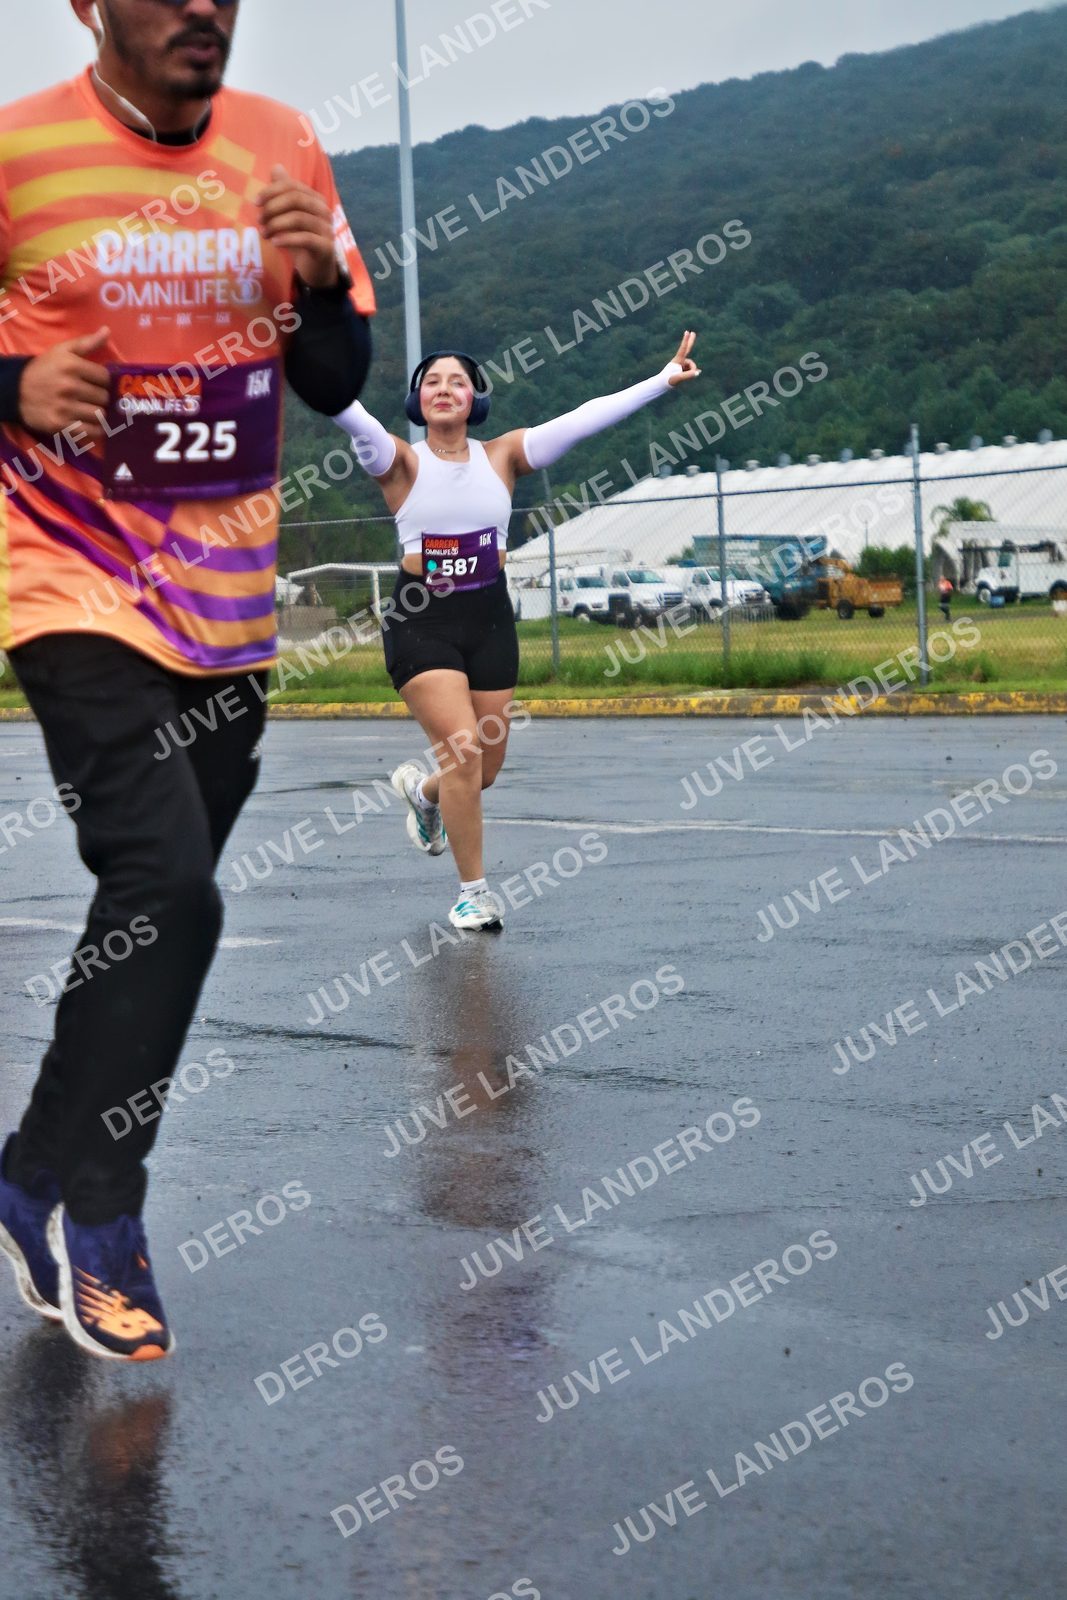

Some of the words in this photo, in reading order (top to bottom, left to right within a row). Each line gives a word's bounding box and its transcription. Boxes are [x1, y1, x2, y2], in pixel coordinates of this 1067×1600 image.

[97, 227, 263, 275] CARRERA
[99, 279, 229, 307] OMNILIFE
[155, 421, 237, 461] 225
[442, 556, 478, 576] 587
